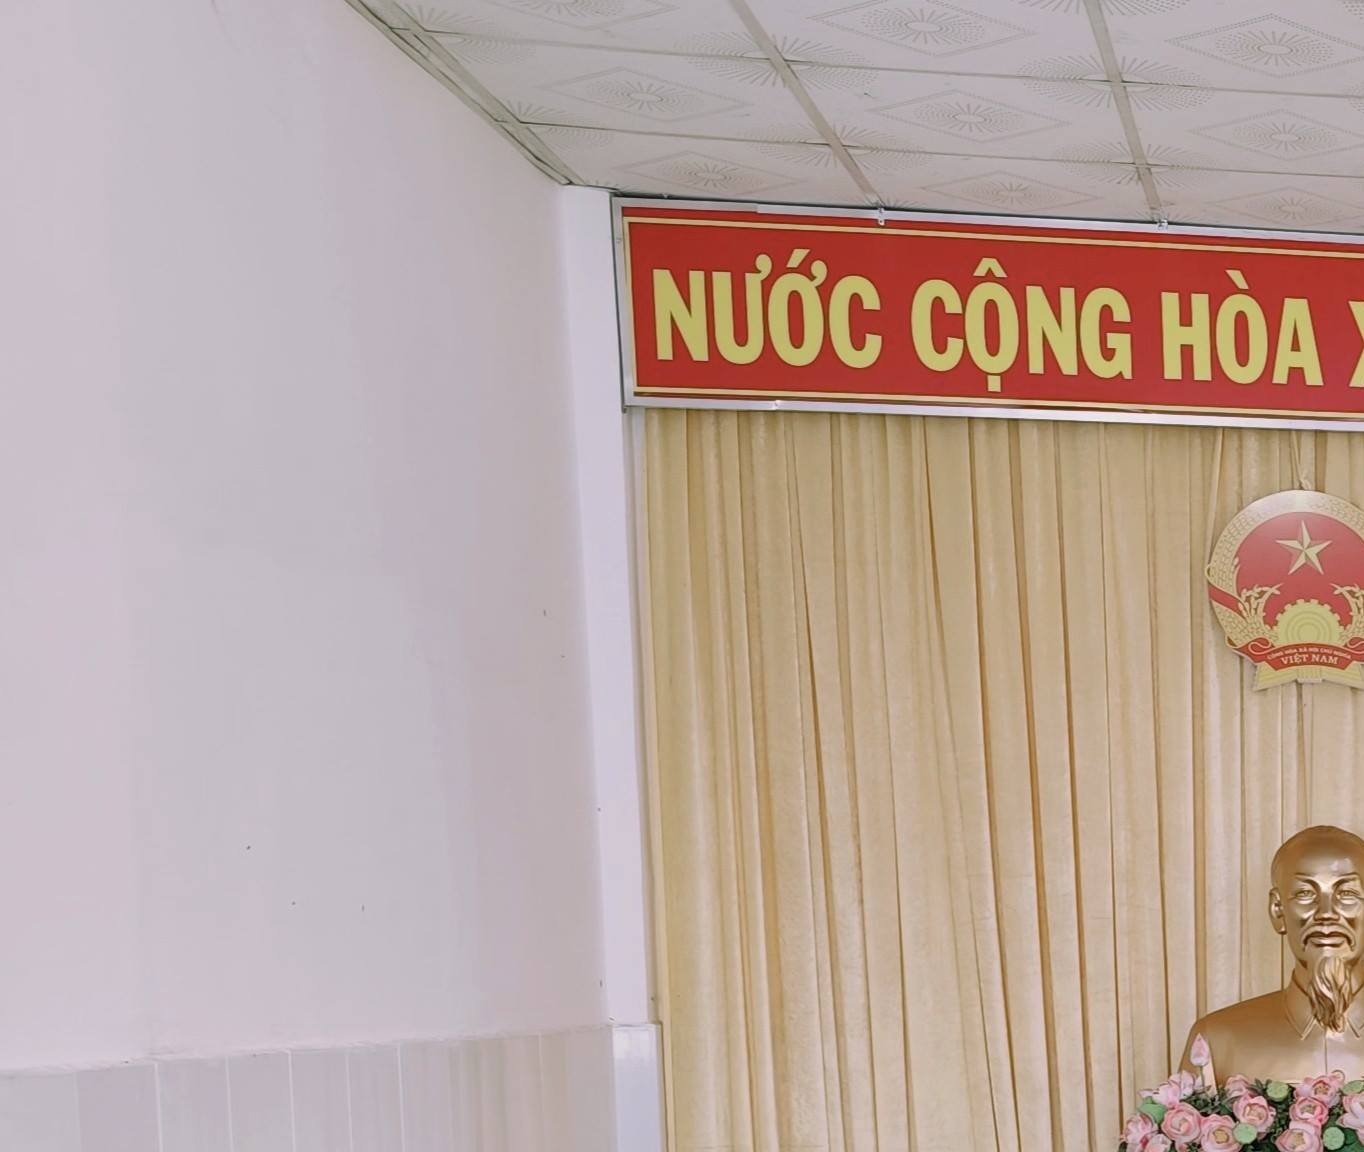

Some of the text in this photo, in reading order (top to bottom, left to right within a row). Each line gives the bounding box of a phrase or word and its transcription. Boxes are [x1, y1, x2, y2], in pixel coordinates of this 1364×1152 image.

[653, 249, 882, 369] NƯỚC
[911, 257, 1133, 392] CỘNG
[1162, 269, 1323, 386] HÒA
